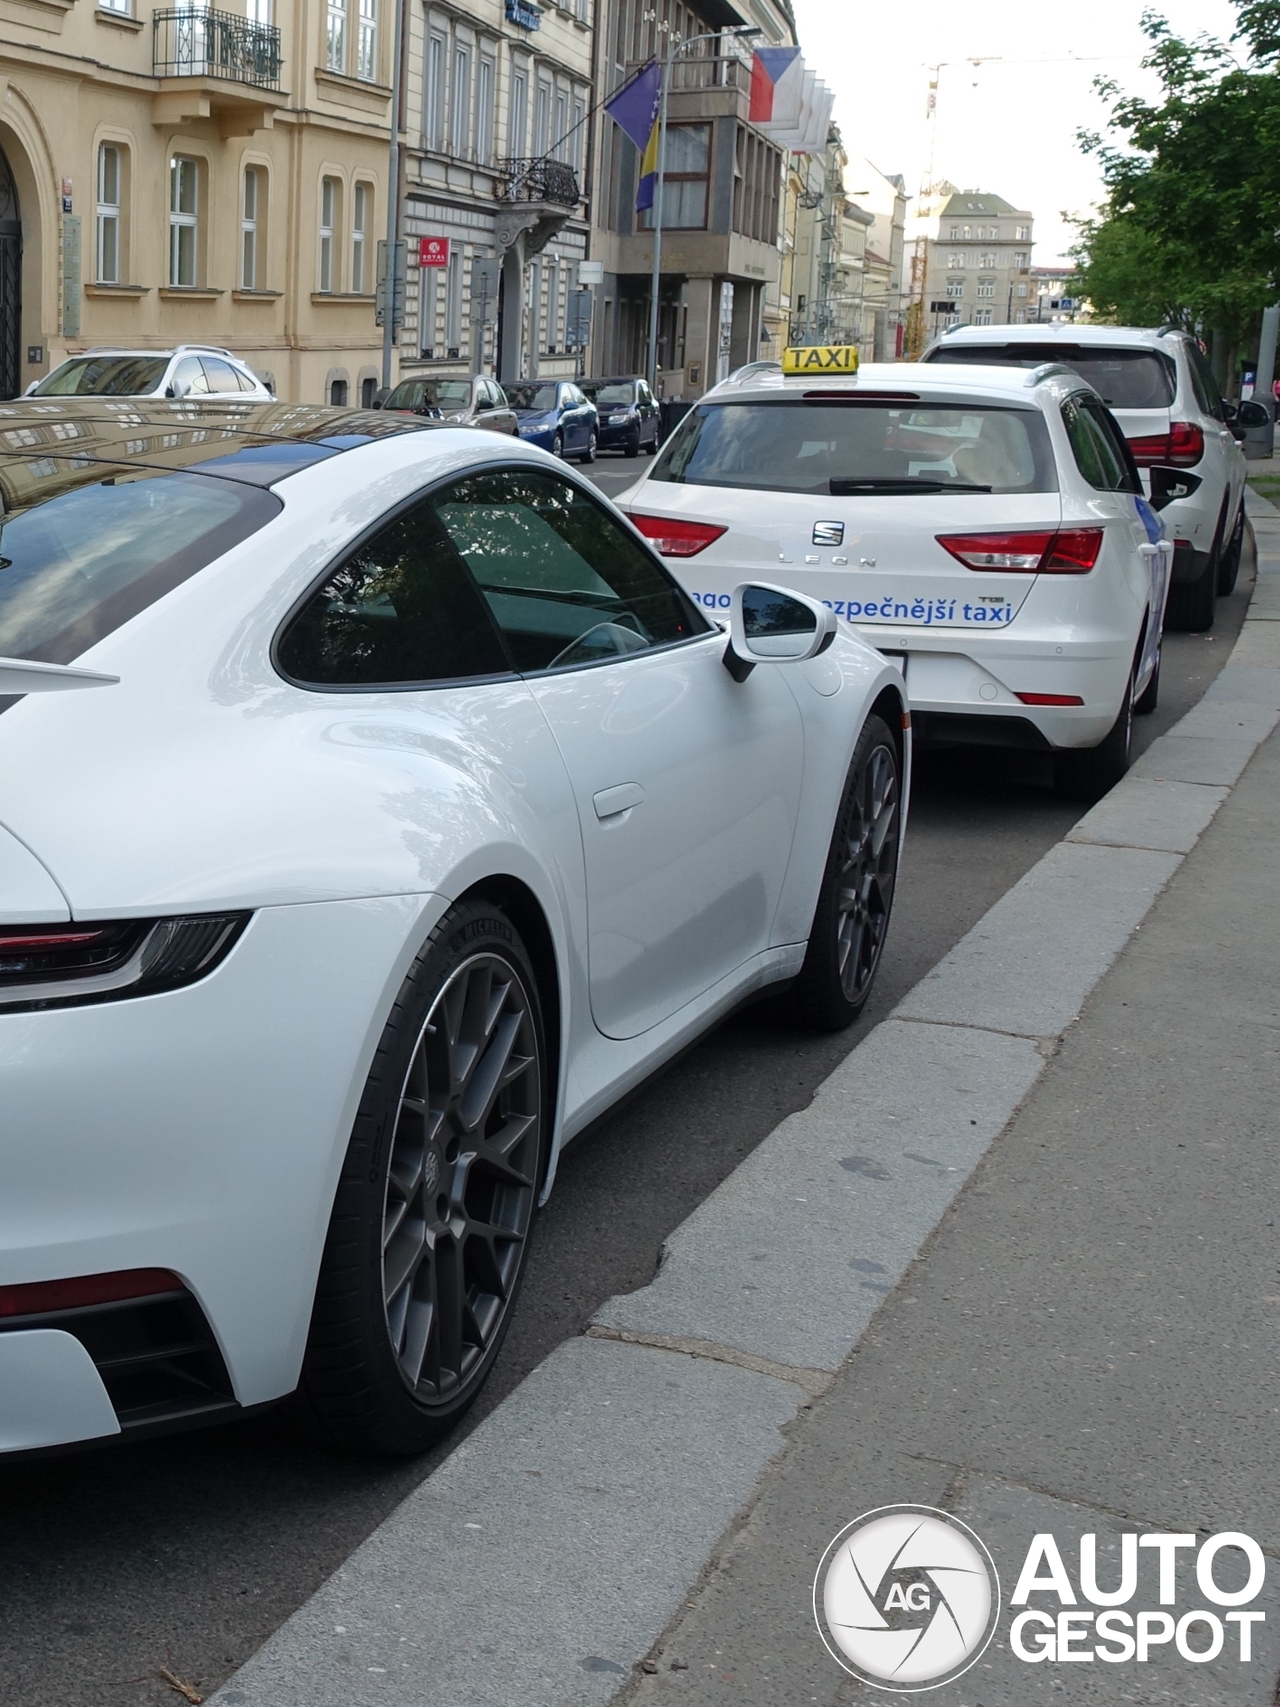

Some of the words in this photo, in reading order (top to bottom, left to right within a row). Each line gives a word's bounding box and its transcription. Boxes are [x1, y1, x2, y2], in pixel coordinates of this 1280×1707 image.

[790, 348, 851, 368] TAXI
[1245, 372, 1253, 381] P
[778, 553, 877, 567] LEON
[962, 602, 1012, 622] taxi
[464, 919, 512, 942] MICHELIN
